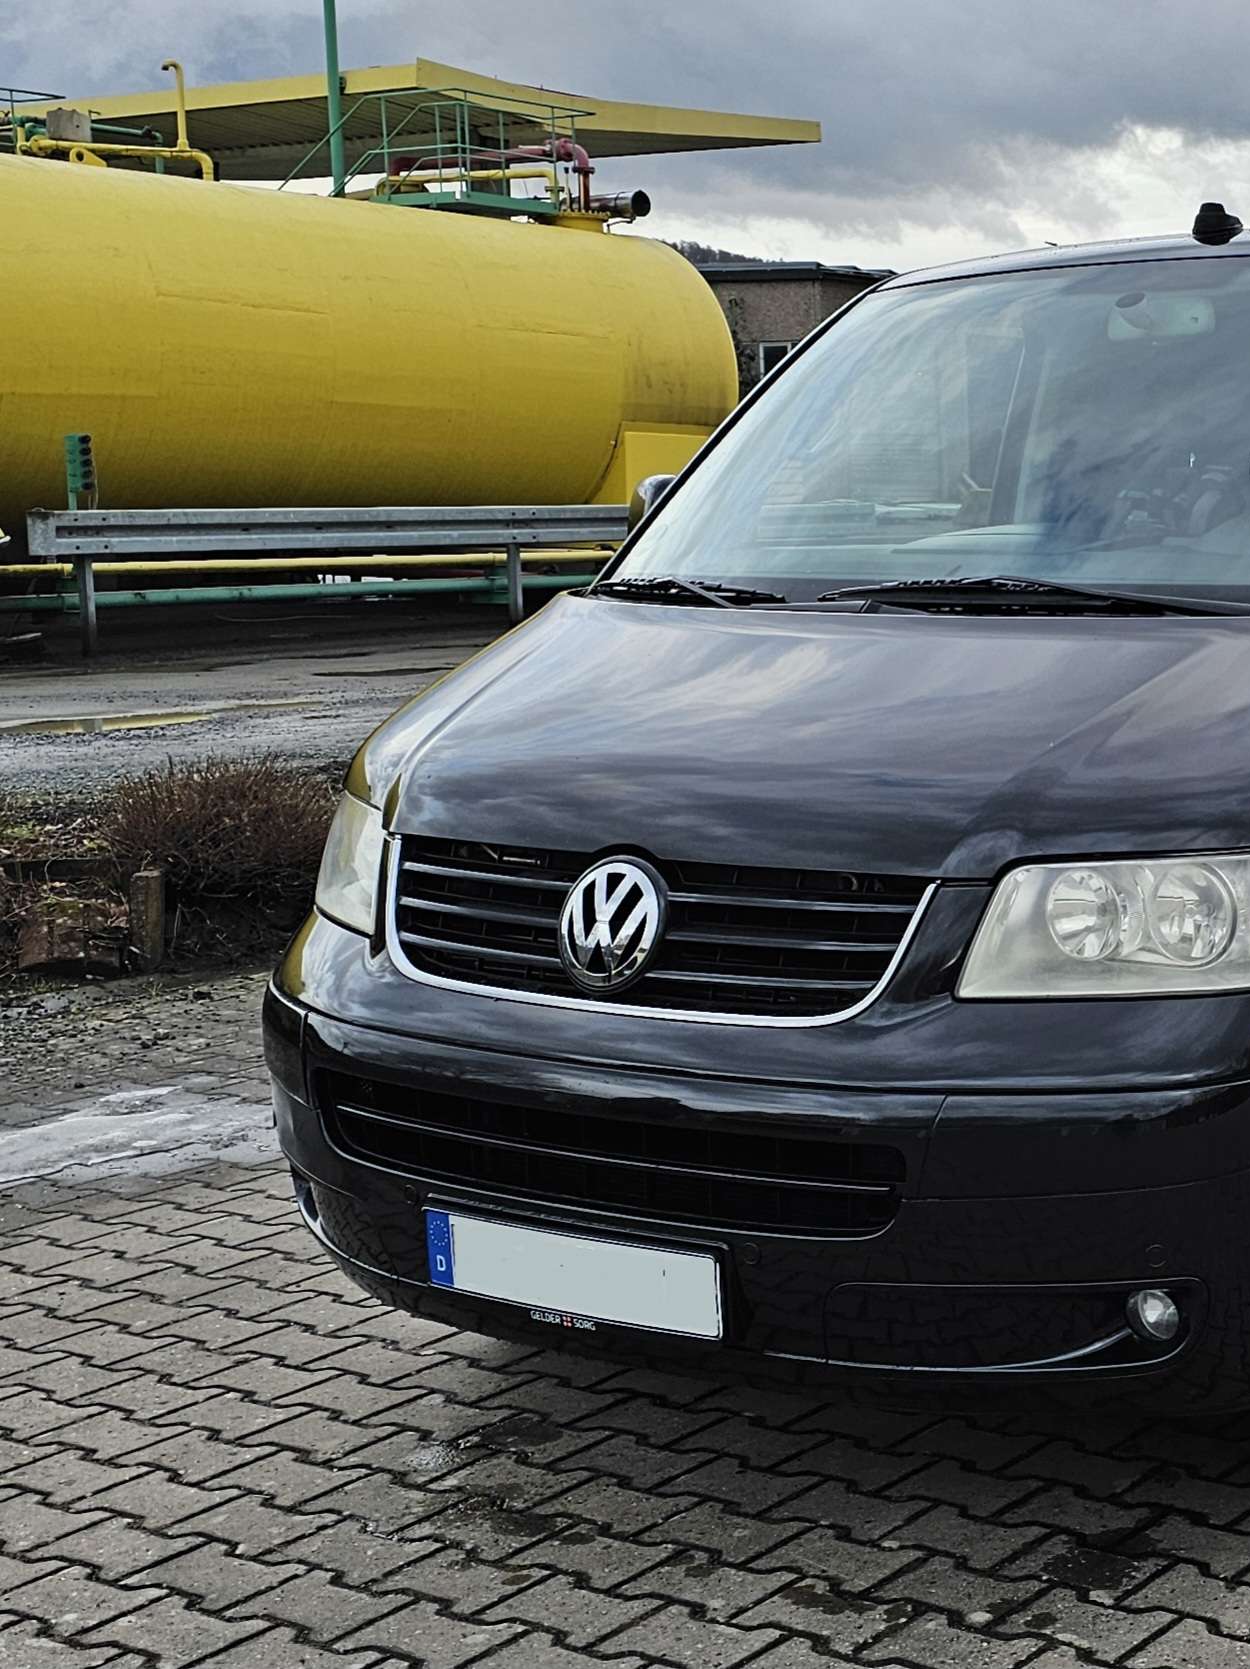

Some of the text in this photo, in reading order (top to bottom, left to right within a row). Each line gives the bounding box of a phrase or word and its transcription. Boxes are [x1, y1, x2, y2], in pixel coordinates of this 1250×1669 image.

[562, 862, 659, 984] VW
[436, 1254, 446, 1272] D
[530, 1310, 596, 1331] GELDER SORG
